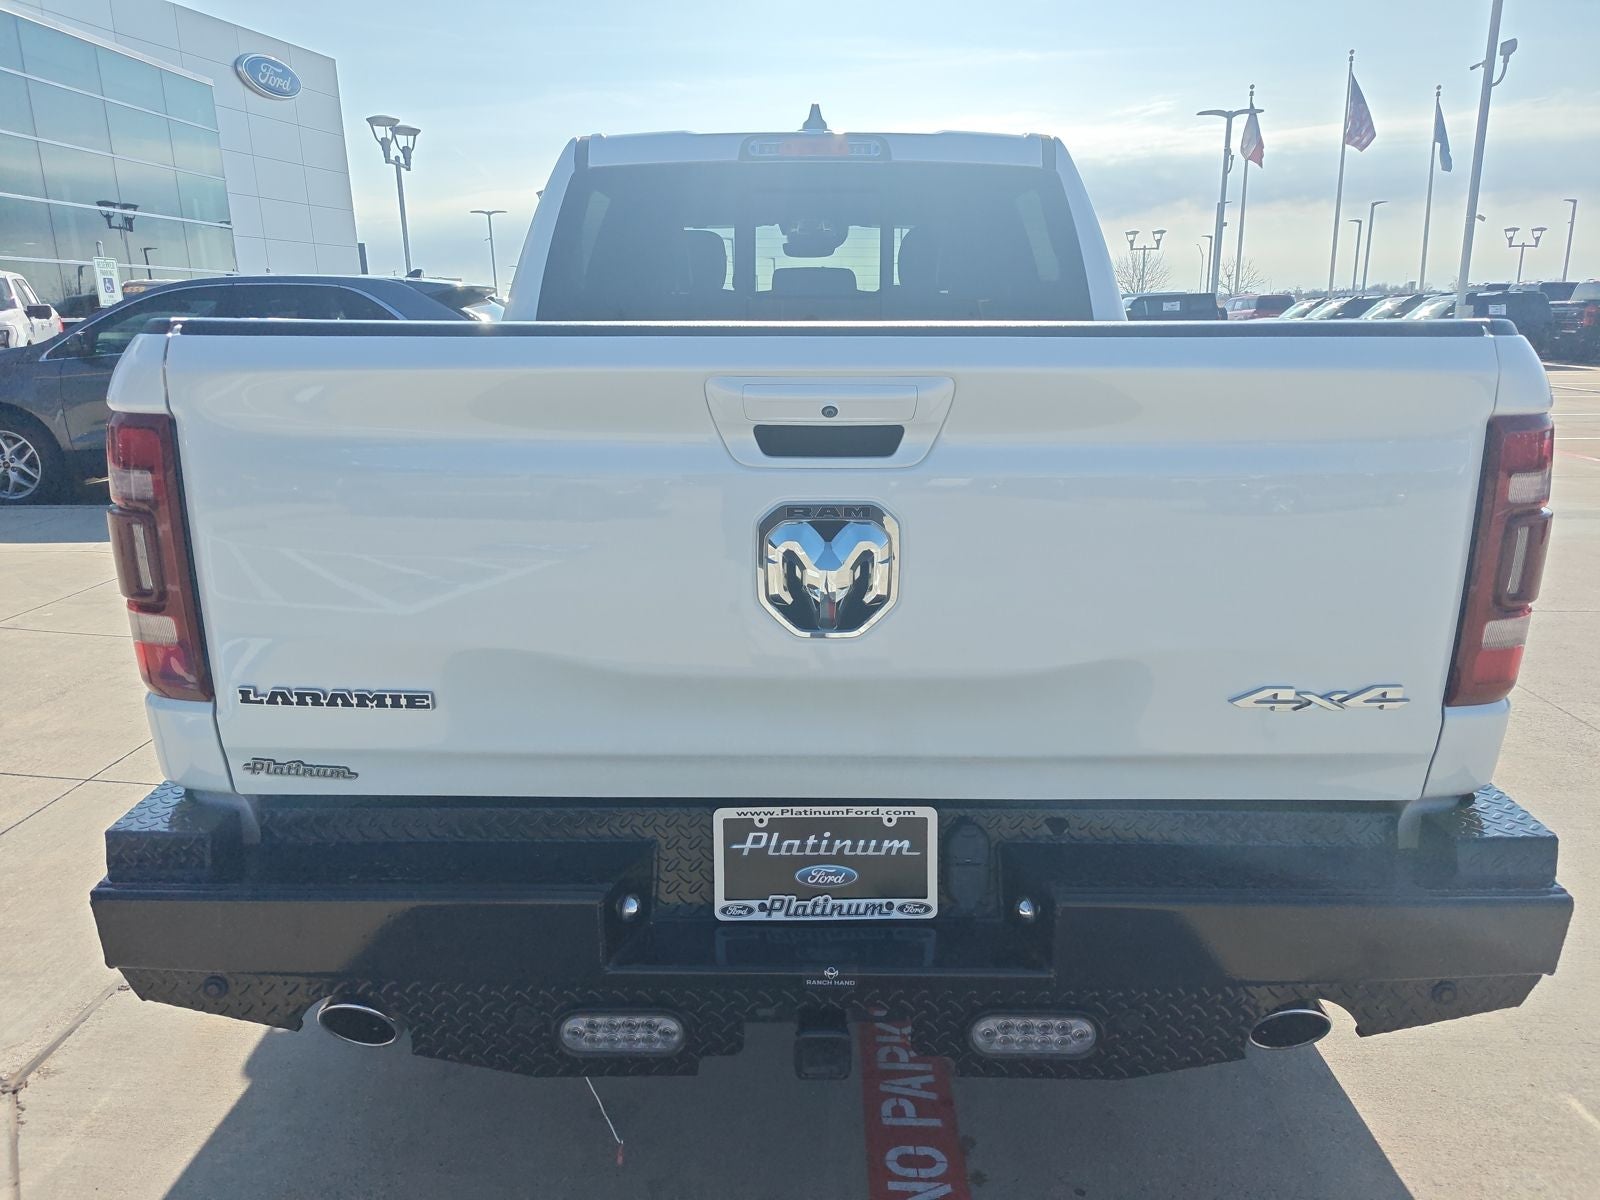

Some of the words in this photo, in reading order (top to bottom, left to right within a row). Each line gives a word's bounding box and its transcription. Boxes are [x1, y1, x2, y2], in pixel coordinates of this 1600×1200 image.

[259, 63, 292, 91] Ford
[786, 506, 871, 519] RAM
[238, 687, 434, 710] LARAMIE
[243, 758, 359, 780] Platinum
[736, 808, 916, 817] www.PlatinumFord.com
[730, 831, 921, 856] Platinum
[807, 868, 846, 884] Ford
[725, 905, 749, 916] Ford
[758, 895, 895, 918] Platinum
[902, 903, 926, 914] Ford
[874, 1009, 944, 1128] PARK
